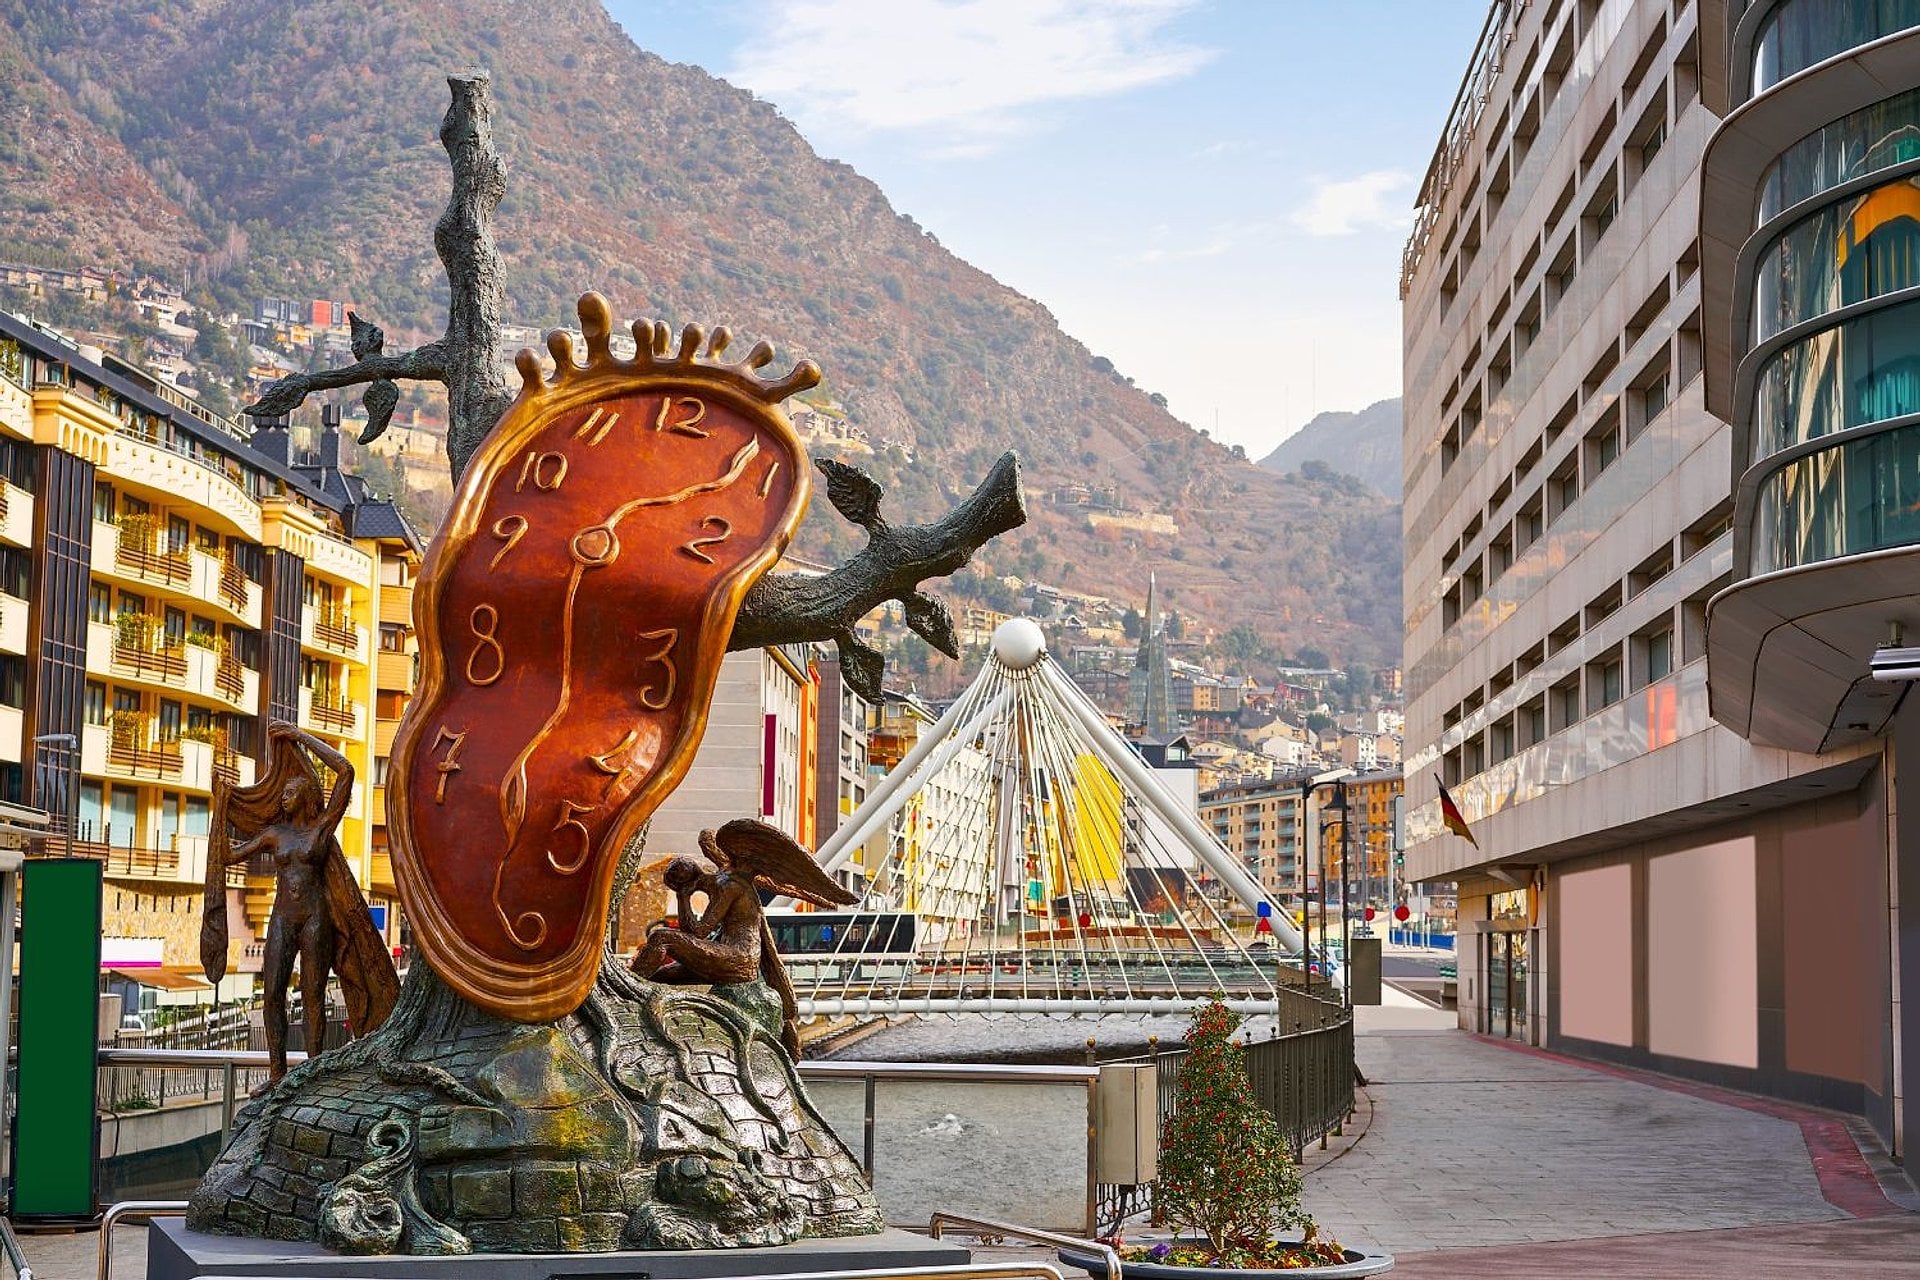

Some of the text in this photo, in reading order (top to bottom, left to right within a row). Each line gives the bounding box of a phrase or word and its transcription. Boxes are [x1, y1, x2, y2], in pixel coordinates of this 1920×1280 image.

[574, 407, 620, 447] 11
[655, 397, 712, 438] 12
[515, 451, 569, 493] 10
[757, 462, 780, 501] 1
[489, 514, 529, 570] 9
[681, 515, 732, 564] 2
[466, 603, 504, 686] 8
[638, 628, 679, 710] 3
[431, 725, 468, 805] 7
[586, 729, 638, 801] 4
[547, 800, 596, 876] 5
[493, 859, 548, 949] 6
